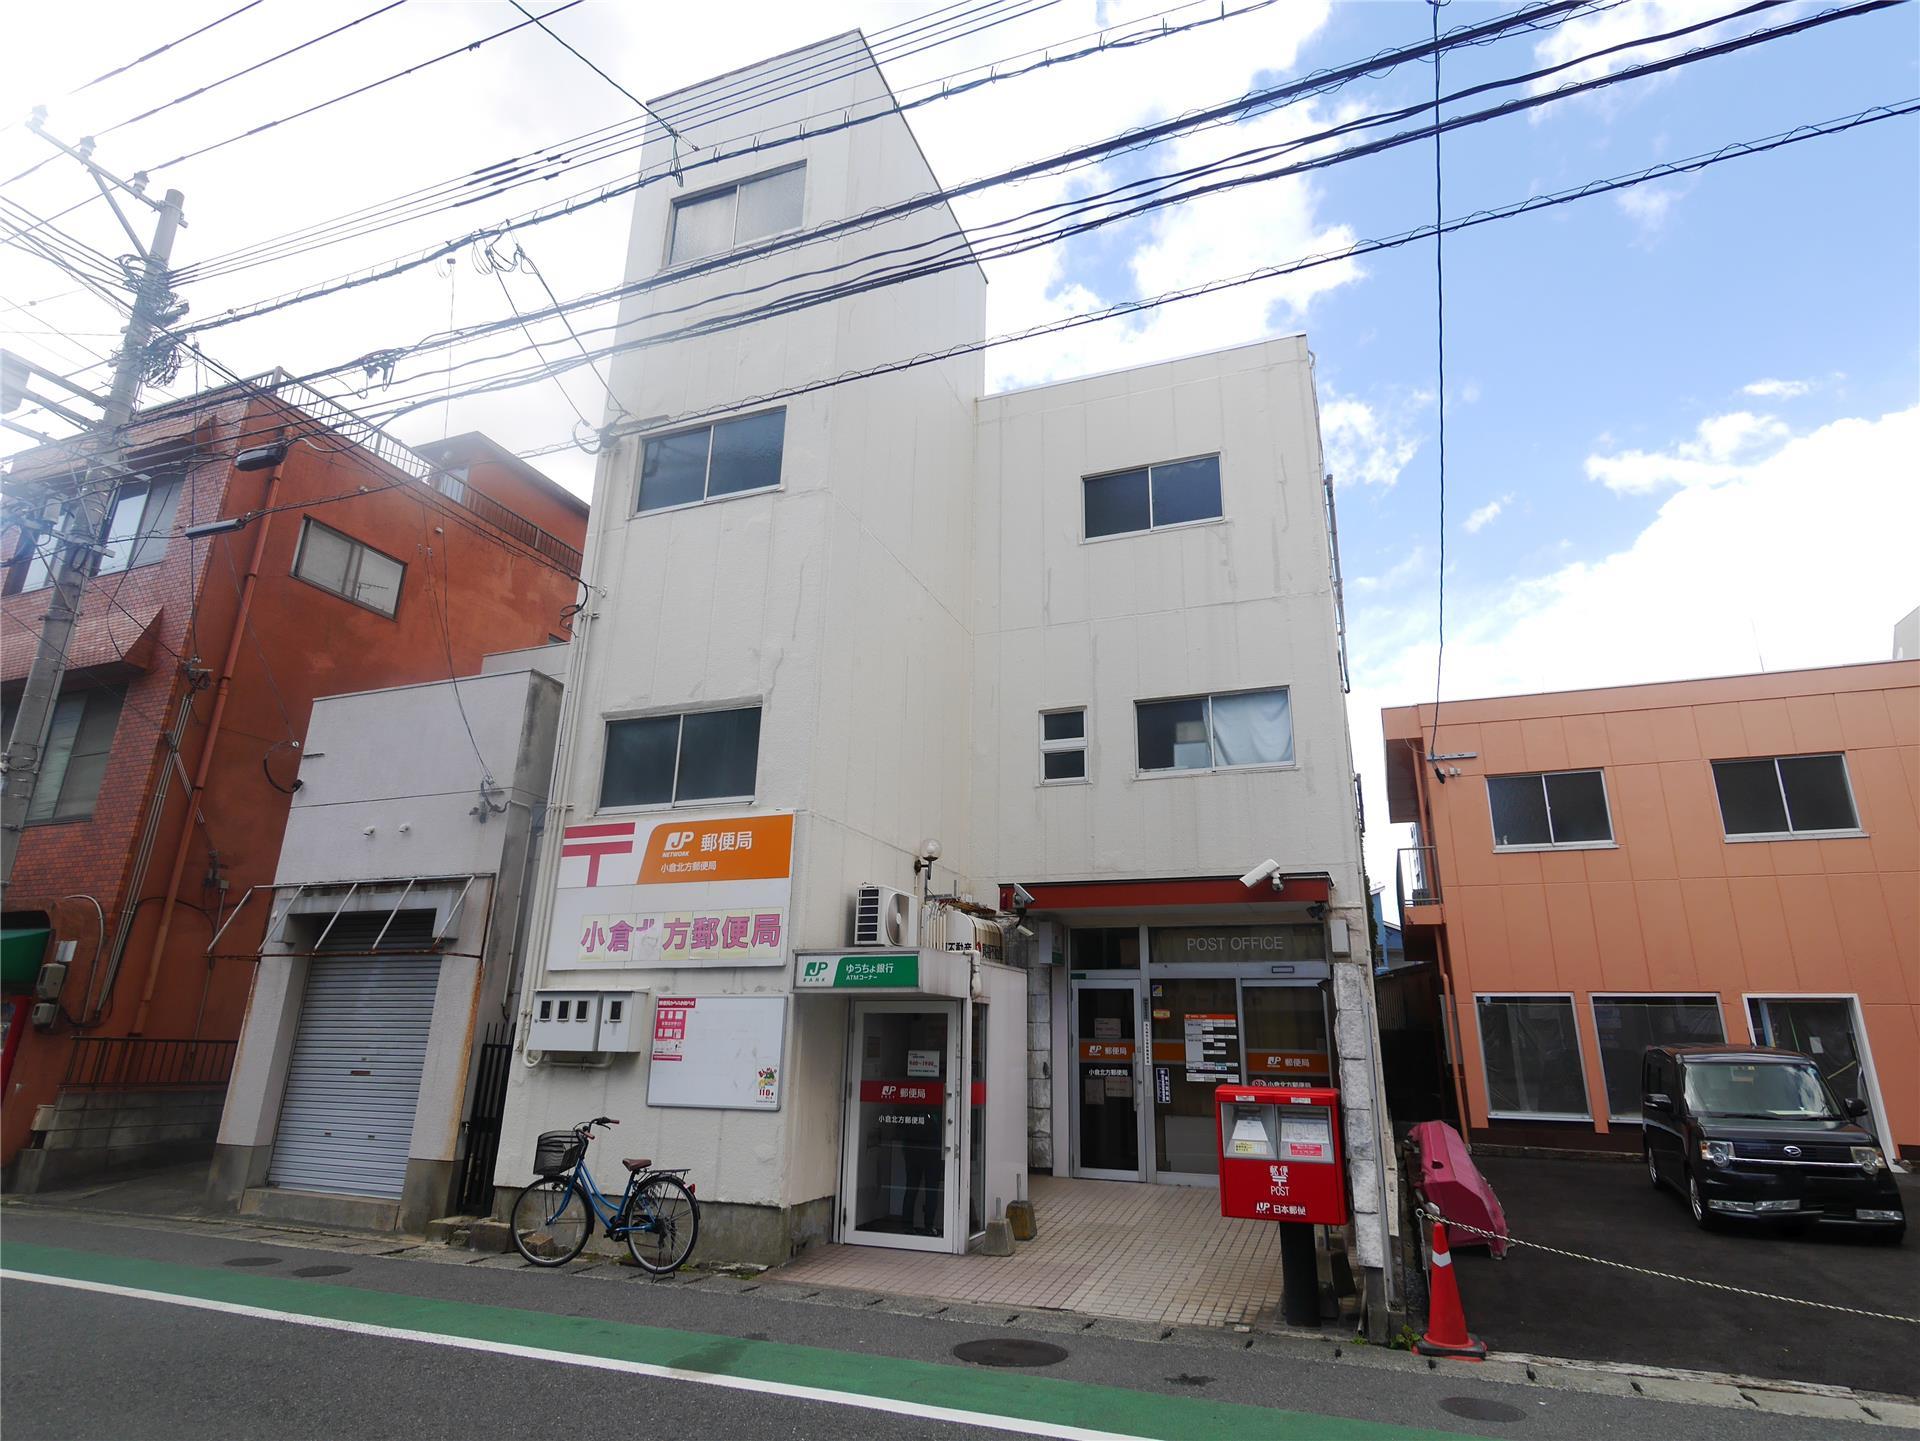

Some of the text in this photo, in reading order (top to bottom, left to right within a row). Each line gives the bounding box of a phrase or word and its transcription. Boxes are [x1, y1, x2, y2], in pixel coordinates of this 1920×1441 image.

[664, 830, 753, 853] JP 郵便局
[661, 850, 690, 858] NETWORK
[660, 860, 717, 874] 小倉北方郵便局
[945, 942, 973, 951] 不動産
[1186, 936, 1284, 952] POST OFFICE
[804, 961, 894, 977] JP ゆうちょ銀行
[1104, 1047, 1128, 1056] 郵便局
[881, 1085, 926, 1099] JP 郵便局
[878, 1115, 925, 1125] 小倉北方郵便局
[1269, 1165, 1289, 1178] 郵便
[1270, 1186, 1290, 1196] POST
[1273, 1204, 1307, 1216] 日本郵便
